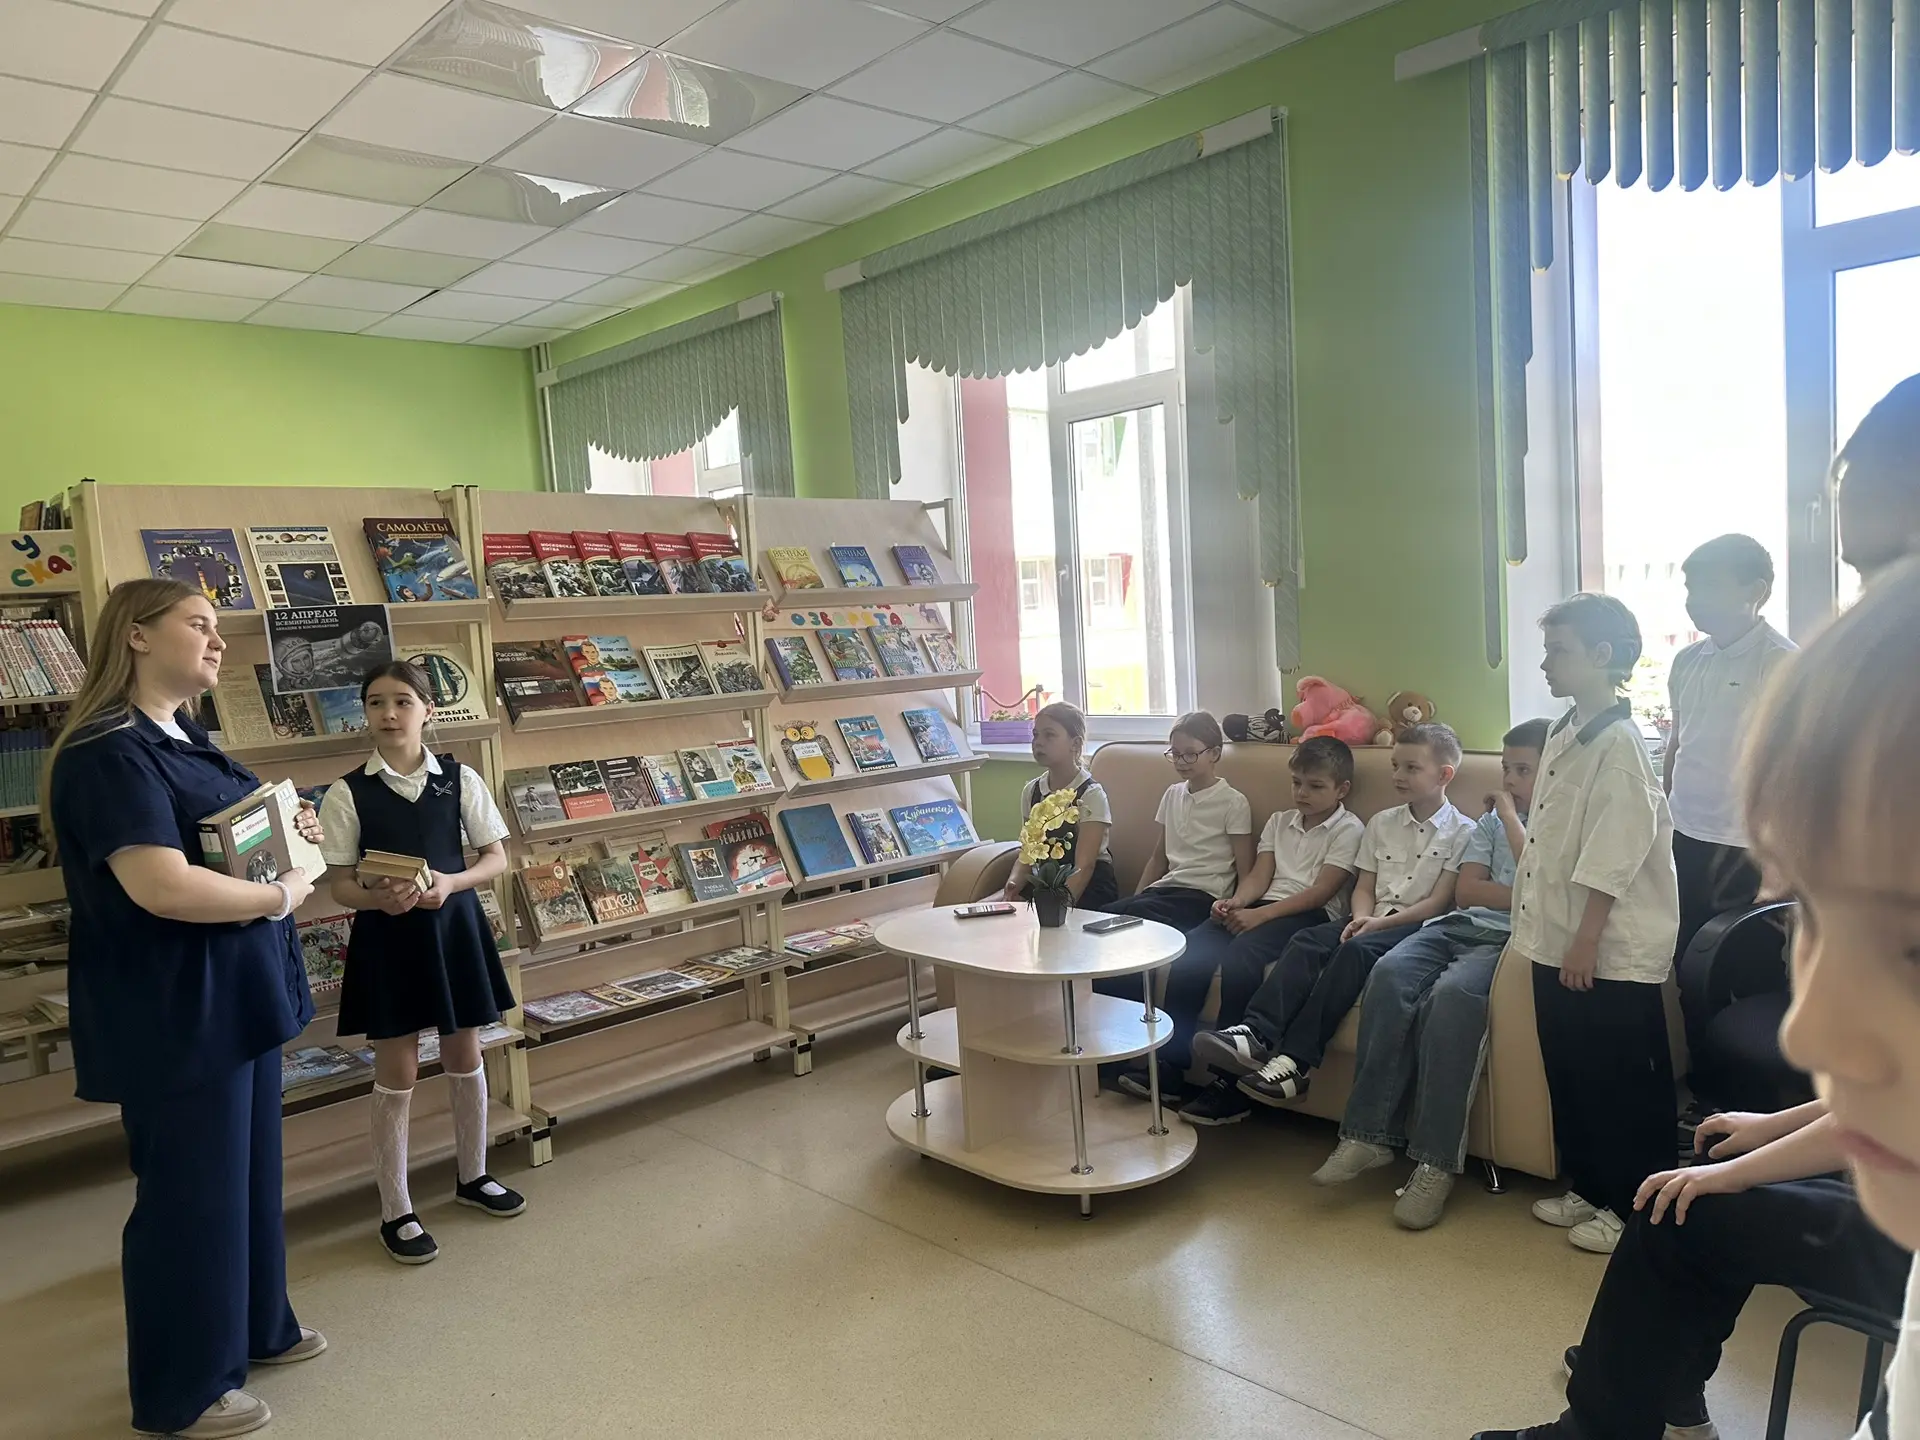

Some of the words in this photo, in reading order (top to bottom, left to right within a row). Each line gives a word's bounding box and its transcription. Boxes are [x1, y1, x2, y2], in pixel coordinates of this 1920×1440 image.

[377, 521, 448, 532] САМОЛЁТЫ
[834, 549, 867, 557] ВЕЧНАЯ
[275, 612, 288, 620] 12
[291, 610, 338, 619] АПРЕЛЯ
[720, 827, 765, 845] ЗЕМЛЯНКА
